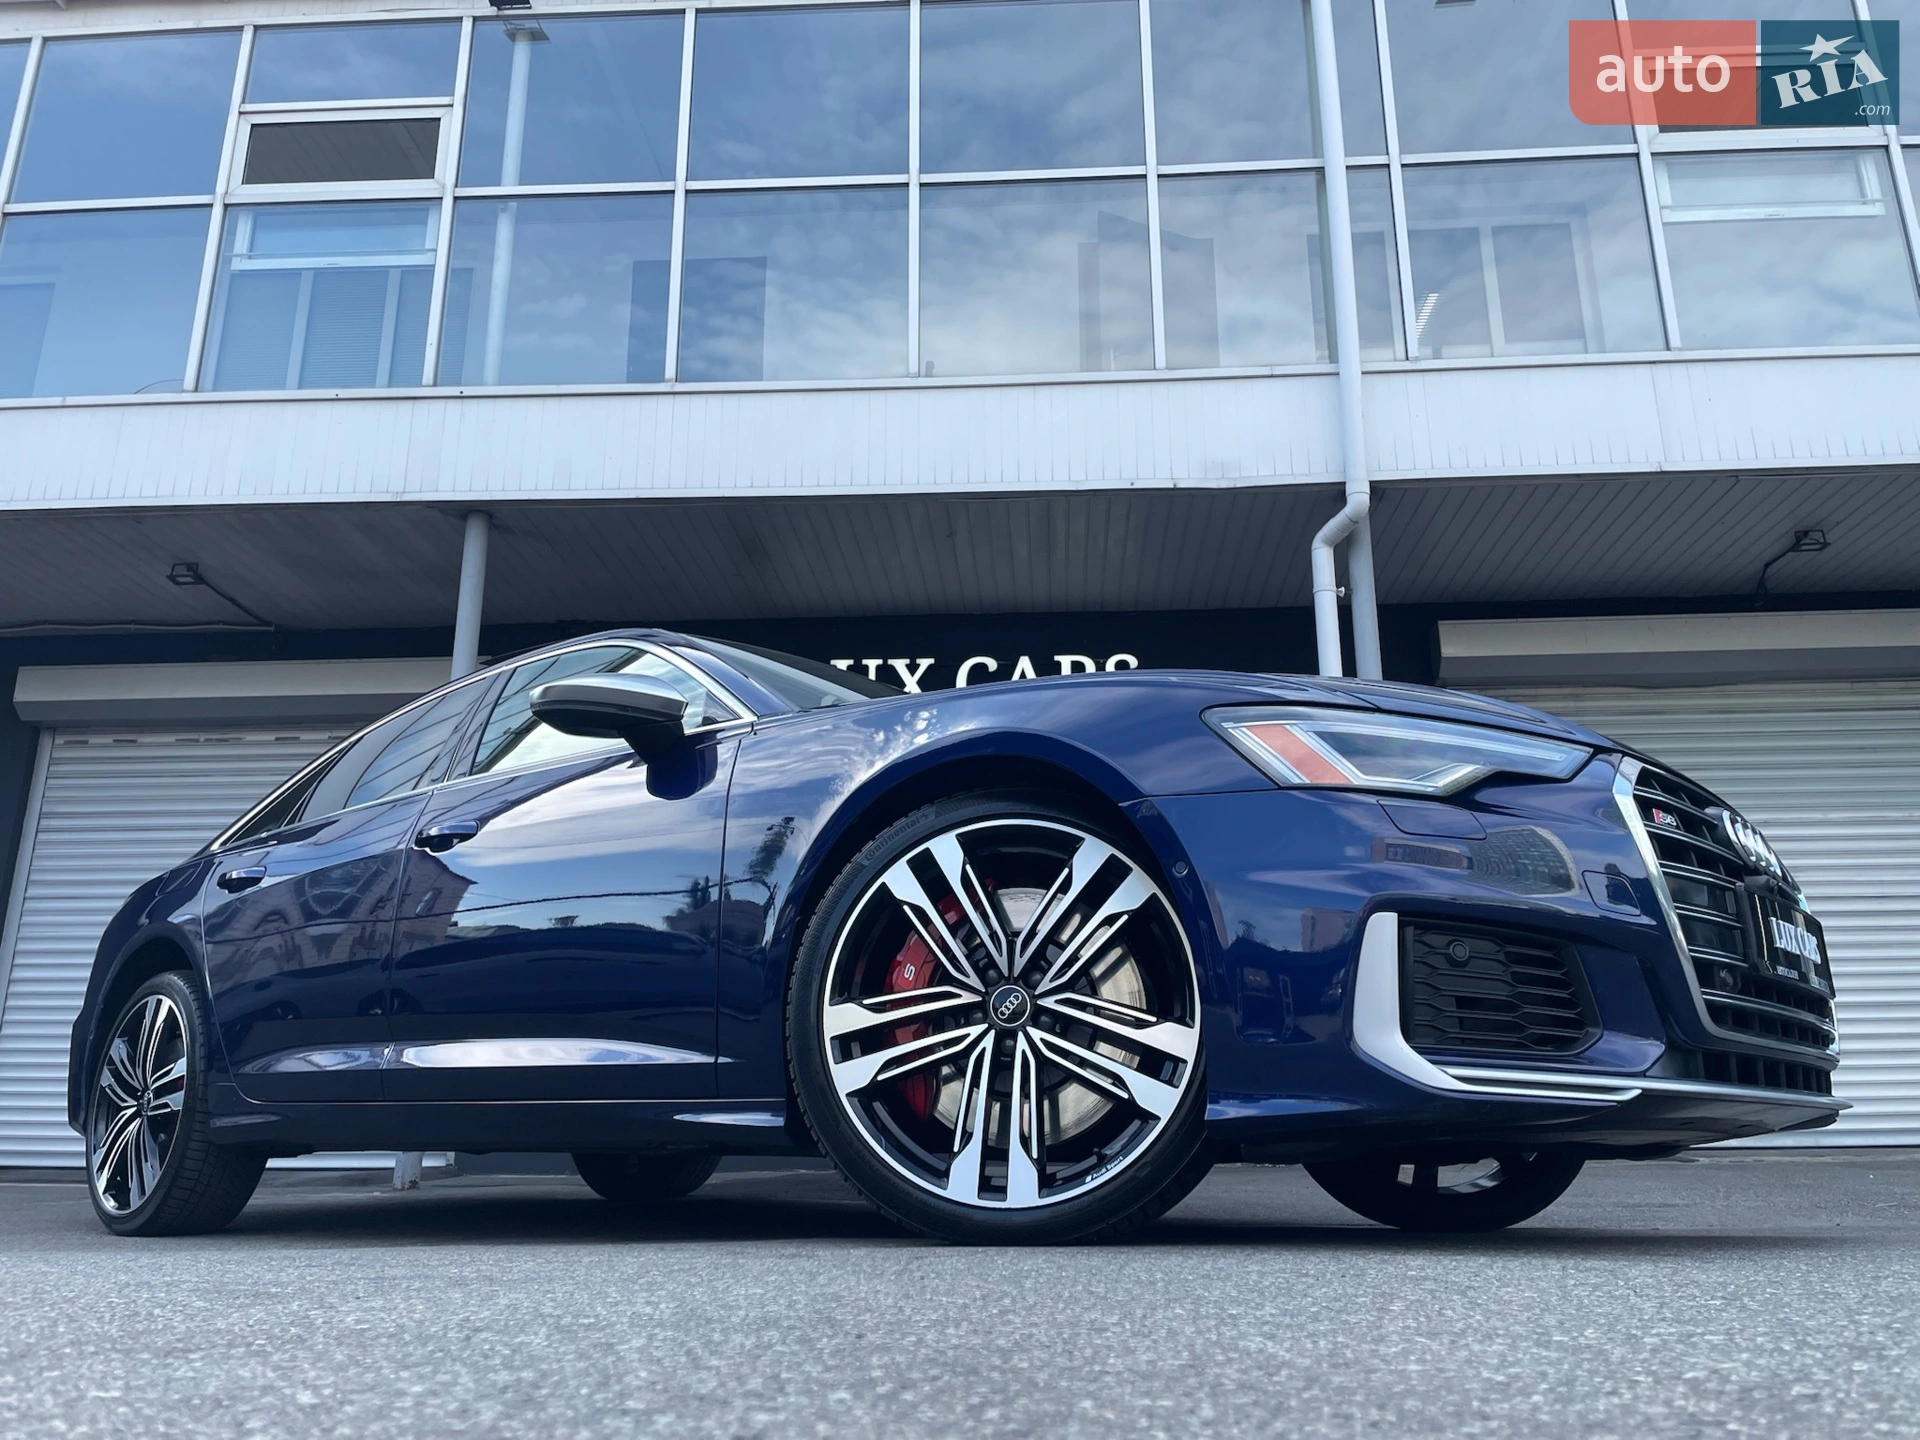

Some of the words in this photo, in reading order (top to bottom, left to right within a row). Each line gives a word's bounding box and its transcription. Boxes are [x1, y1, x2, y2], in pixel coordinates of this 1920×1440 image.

[864, 815, 922, 861] Continental
[1768, 916, 1801, 955] LUX
[904, 963, 915, 981] S
